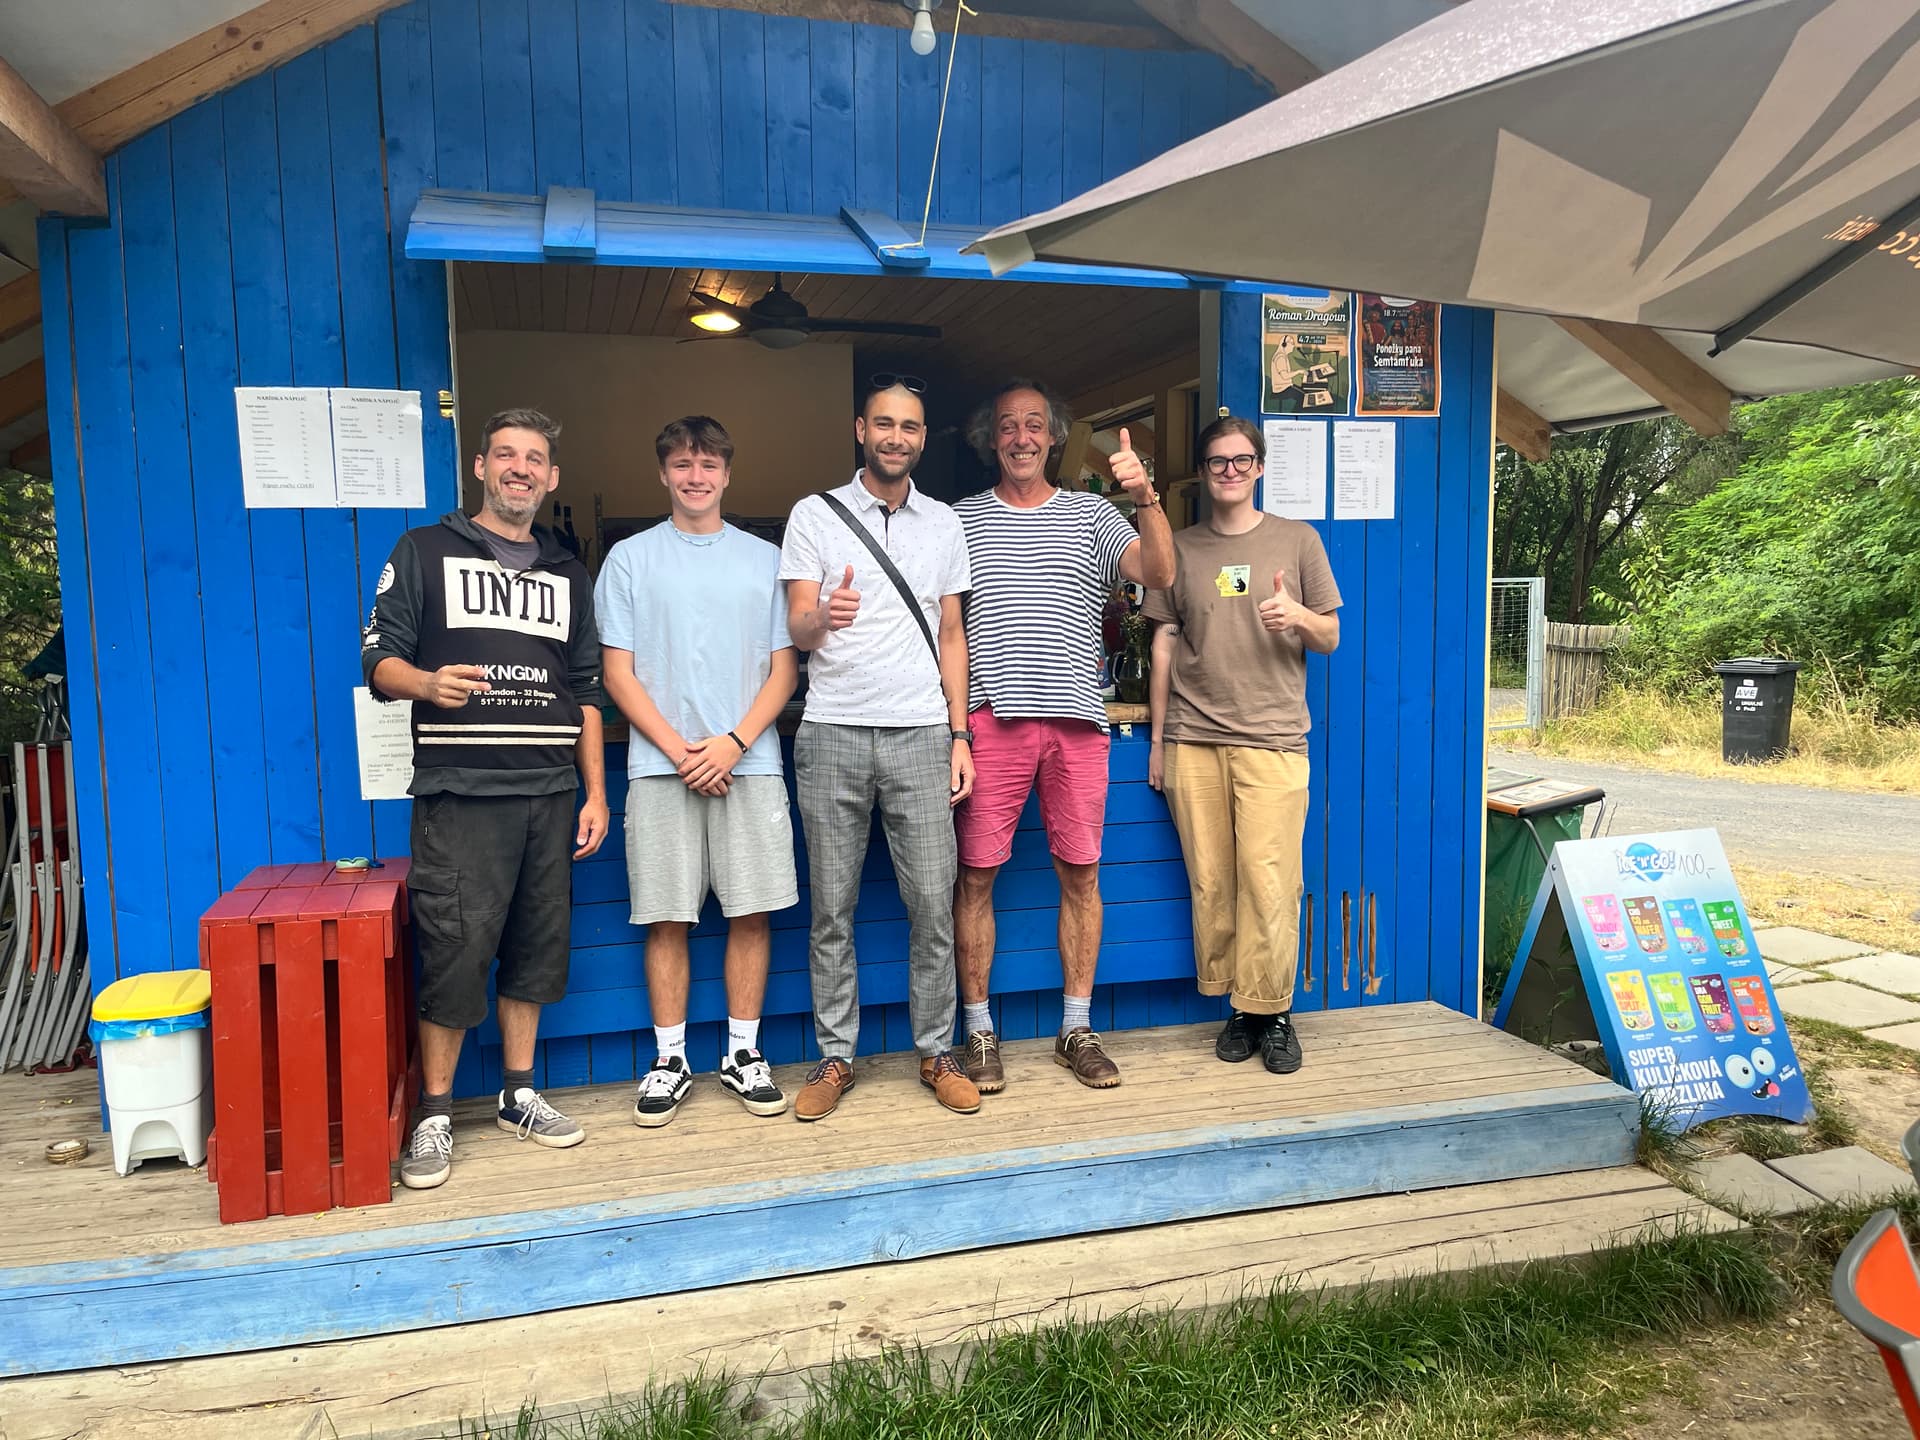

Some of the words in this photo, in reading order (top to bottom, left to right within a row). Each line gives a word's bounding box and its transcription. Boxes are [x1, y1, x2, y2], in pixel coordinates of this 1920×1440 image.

[1268, 308, 1302, 320] Roman
[1304, 309, 1346, 327] Dragoun
[1376, 343, 1403, 356] Ponožky
[1404, 345, 1422, 355] pana
[460, 569, 560, 627] UNTD.
[523, 689, 532, 697] 32
[1628, 1045, 1676, 1067] SUPER
